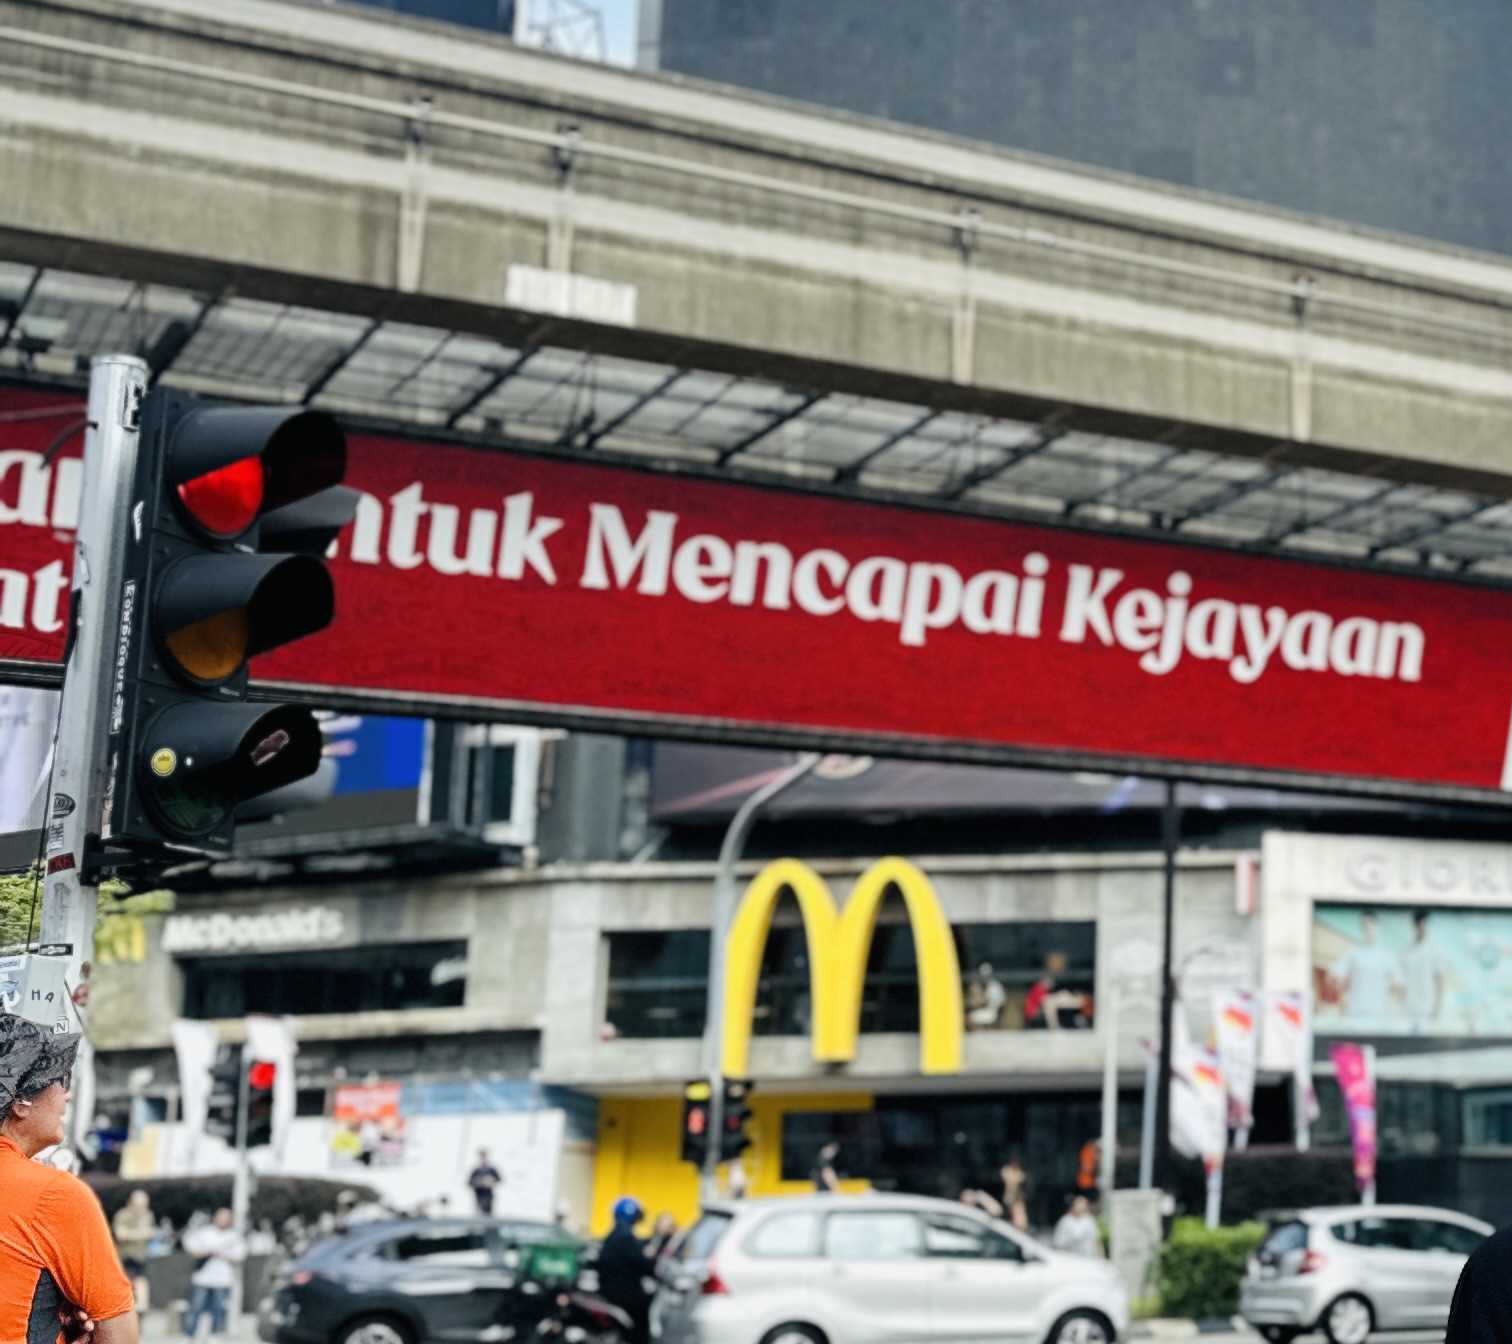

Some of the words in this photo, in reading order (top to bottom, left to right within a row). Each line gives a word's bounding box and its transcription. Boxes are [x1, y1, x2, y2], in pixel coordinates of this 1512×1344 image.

[326, 481, 564, 586] ntuk
[579, 501, 1049, 647] Mencapai
[1059, 562, 1425, 684] Kejayaan
[161, 906, 344, 954] McDonald's
